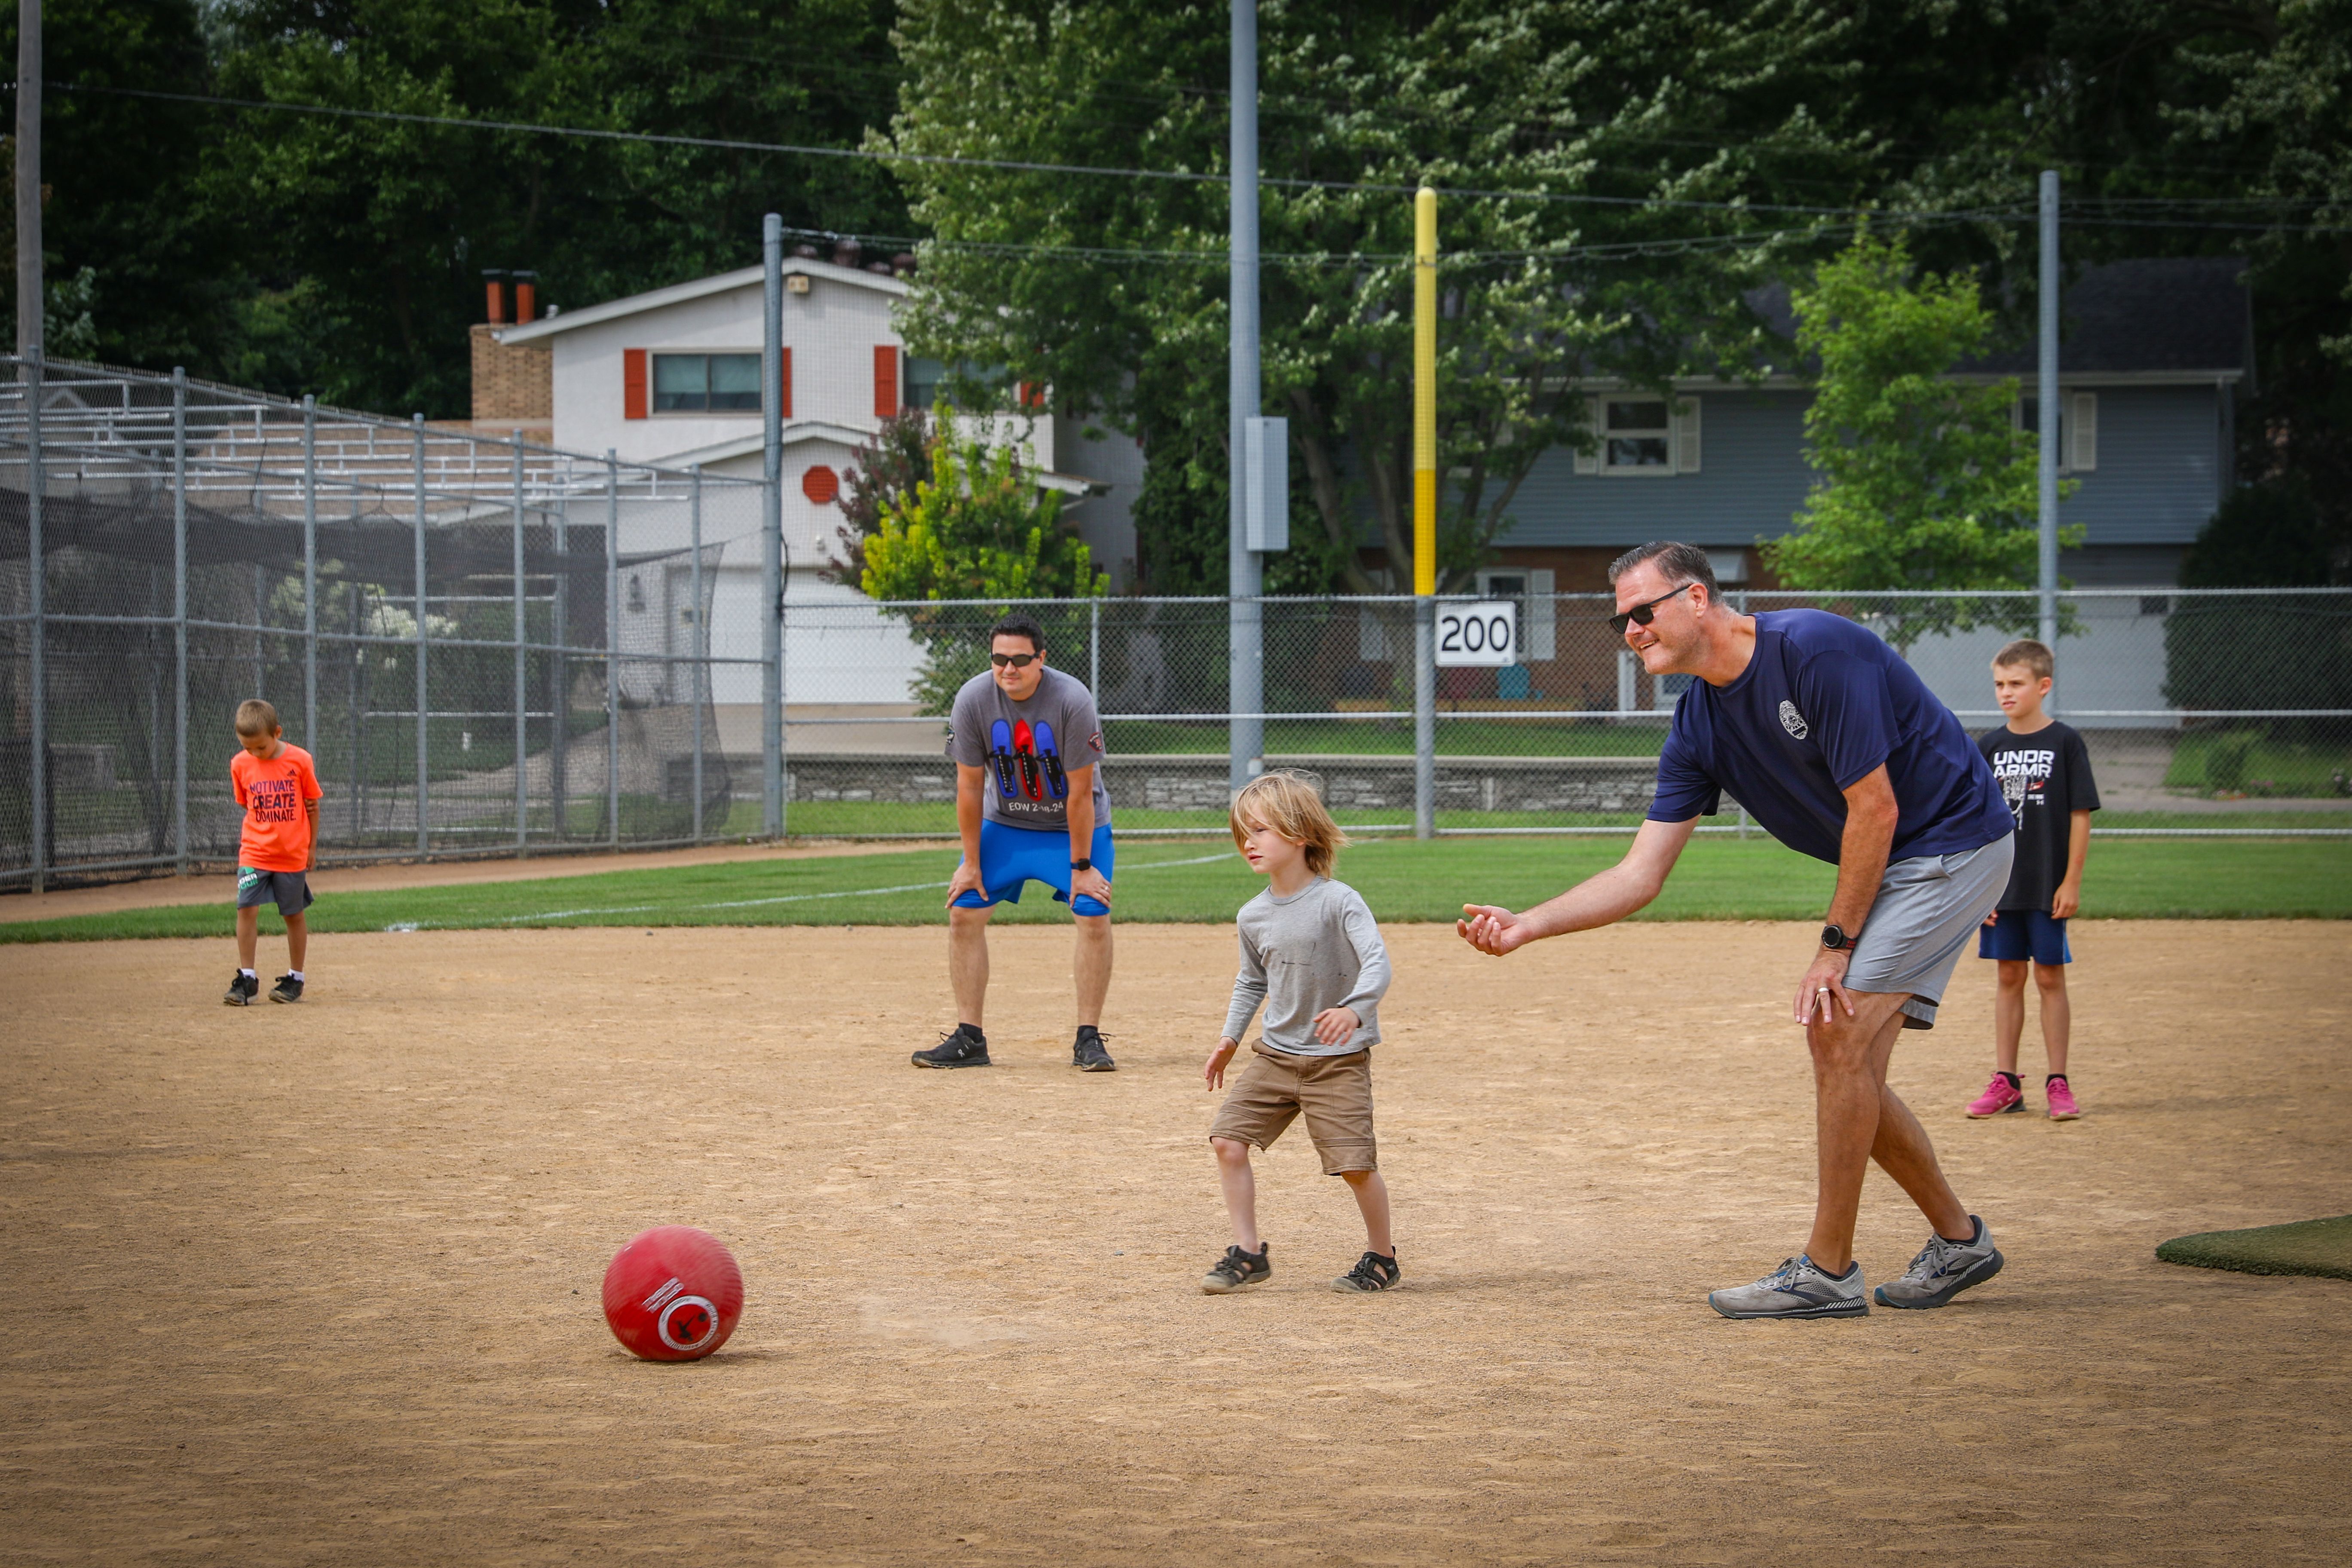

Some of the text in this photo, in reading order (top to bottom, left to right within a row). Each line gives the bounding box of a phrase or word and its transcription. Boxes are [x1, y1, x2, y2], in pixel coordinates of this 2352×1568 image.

[1442, 616, 1509, 652] 200
[1993, 749, 2055, 766] UNDR
[1993, 763, 2052, 779] ARMR
[253, 793, 297, 809] CREATE.
[1009, 802, 1030, 812] EOW
[255, 808, 297, 823] DOMINATE.
